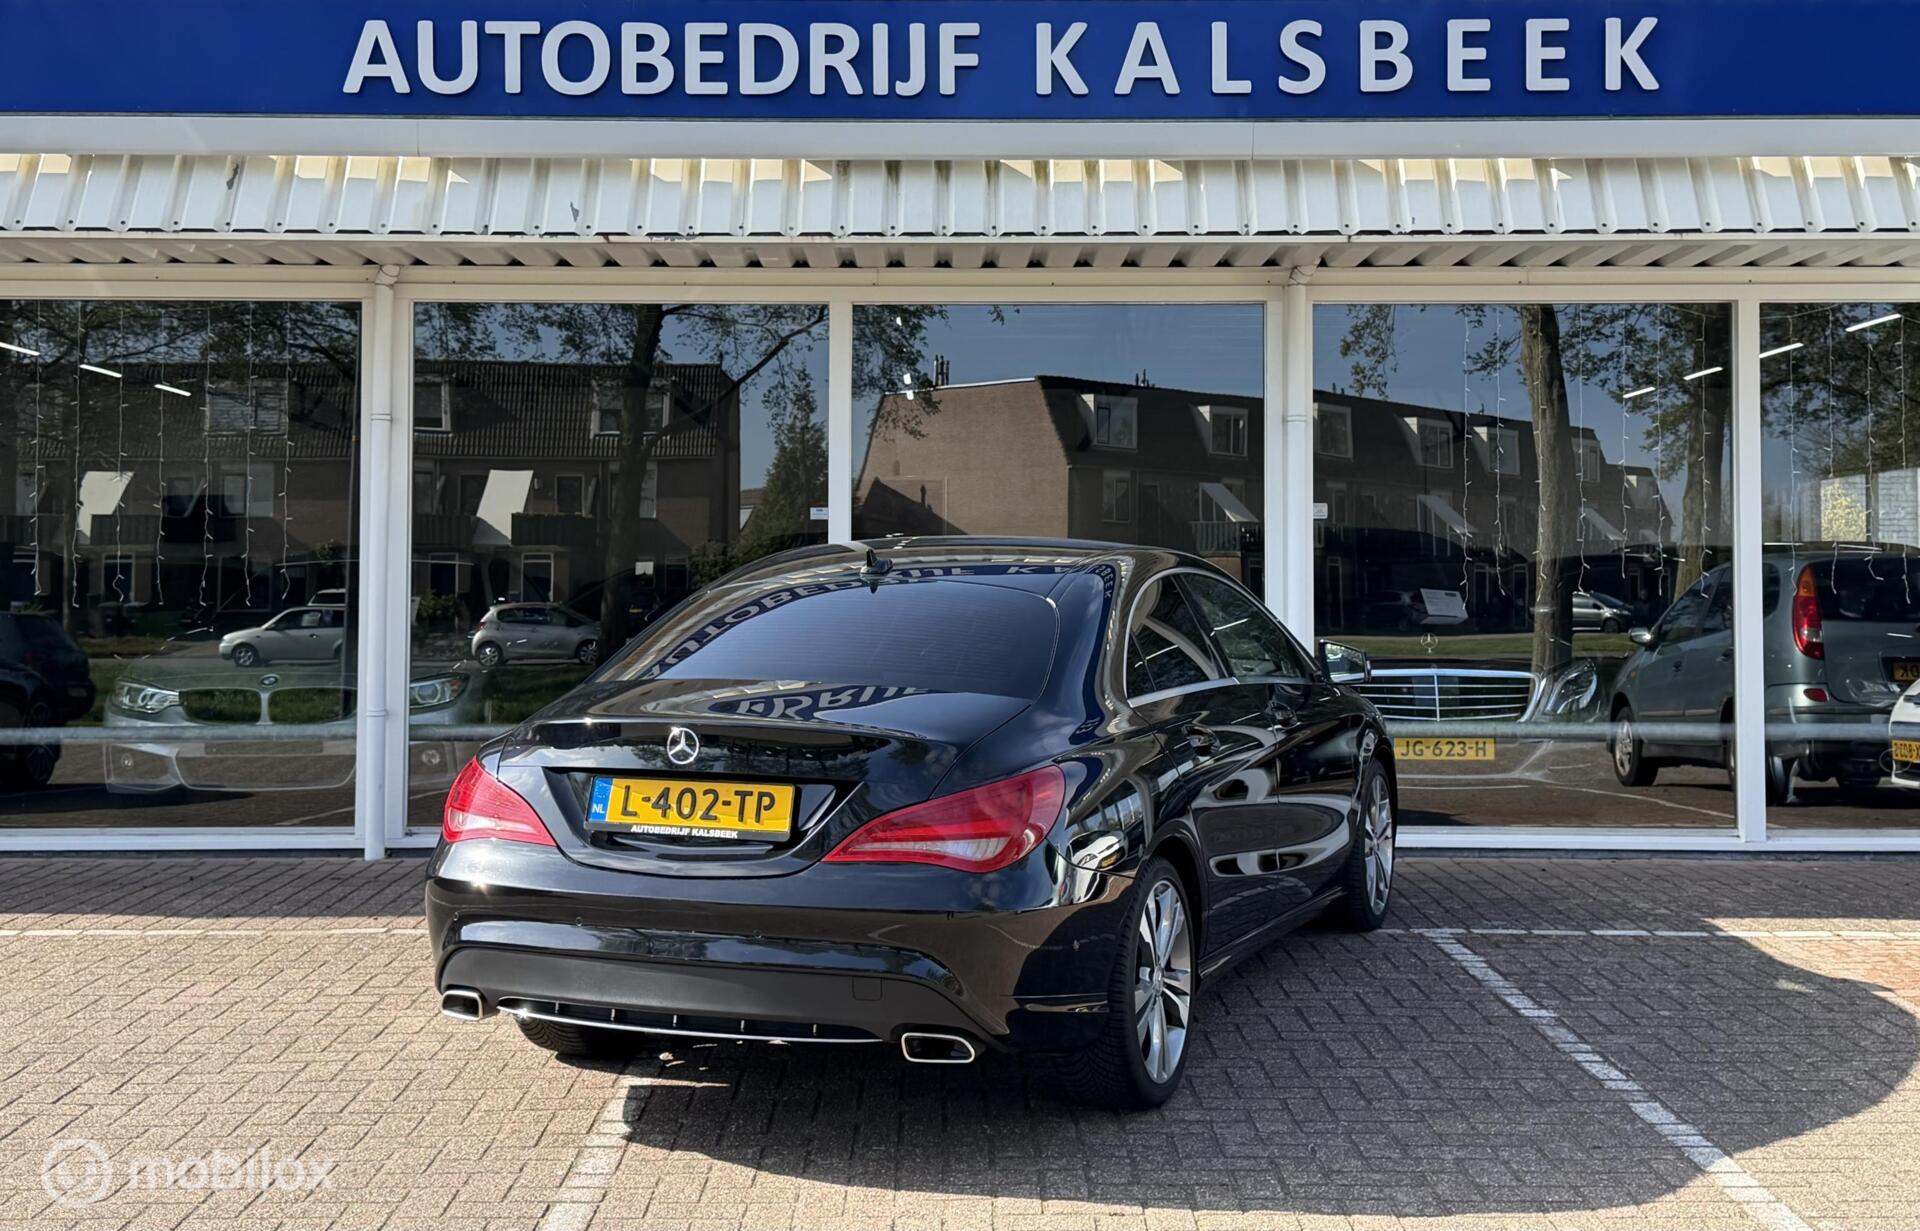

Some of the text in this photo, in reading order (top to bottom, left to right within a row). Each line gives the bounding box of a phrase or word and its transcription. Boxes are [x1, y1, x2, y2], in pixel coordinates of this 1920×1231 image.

[342, 17, 1660, 96] AUTOBEDRIJF KALSBEEK
[1401, 740, 1487, 757] JG-623-H
[592, 803, 606, 814] NL
[621, 785, 776, 823] L-402-TP
[630, 824, 738, 839] AUTOBEDRIJF KALSBEEK
